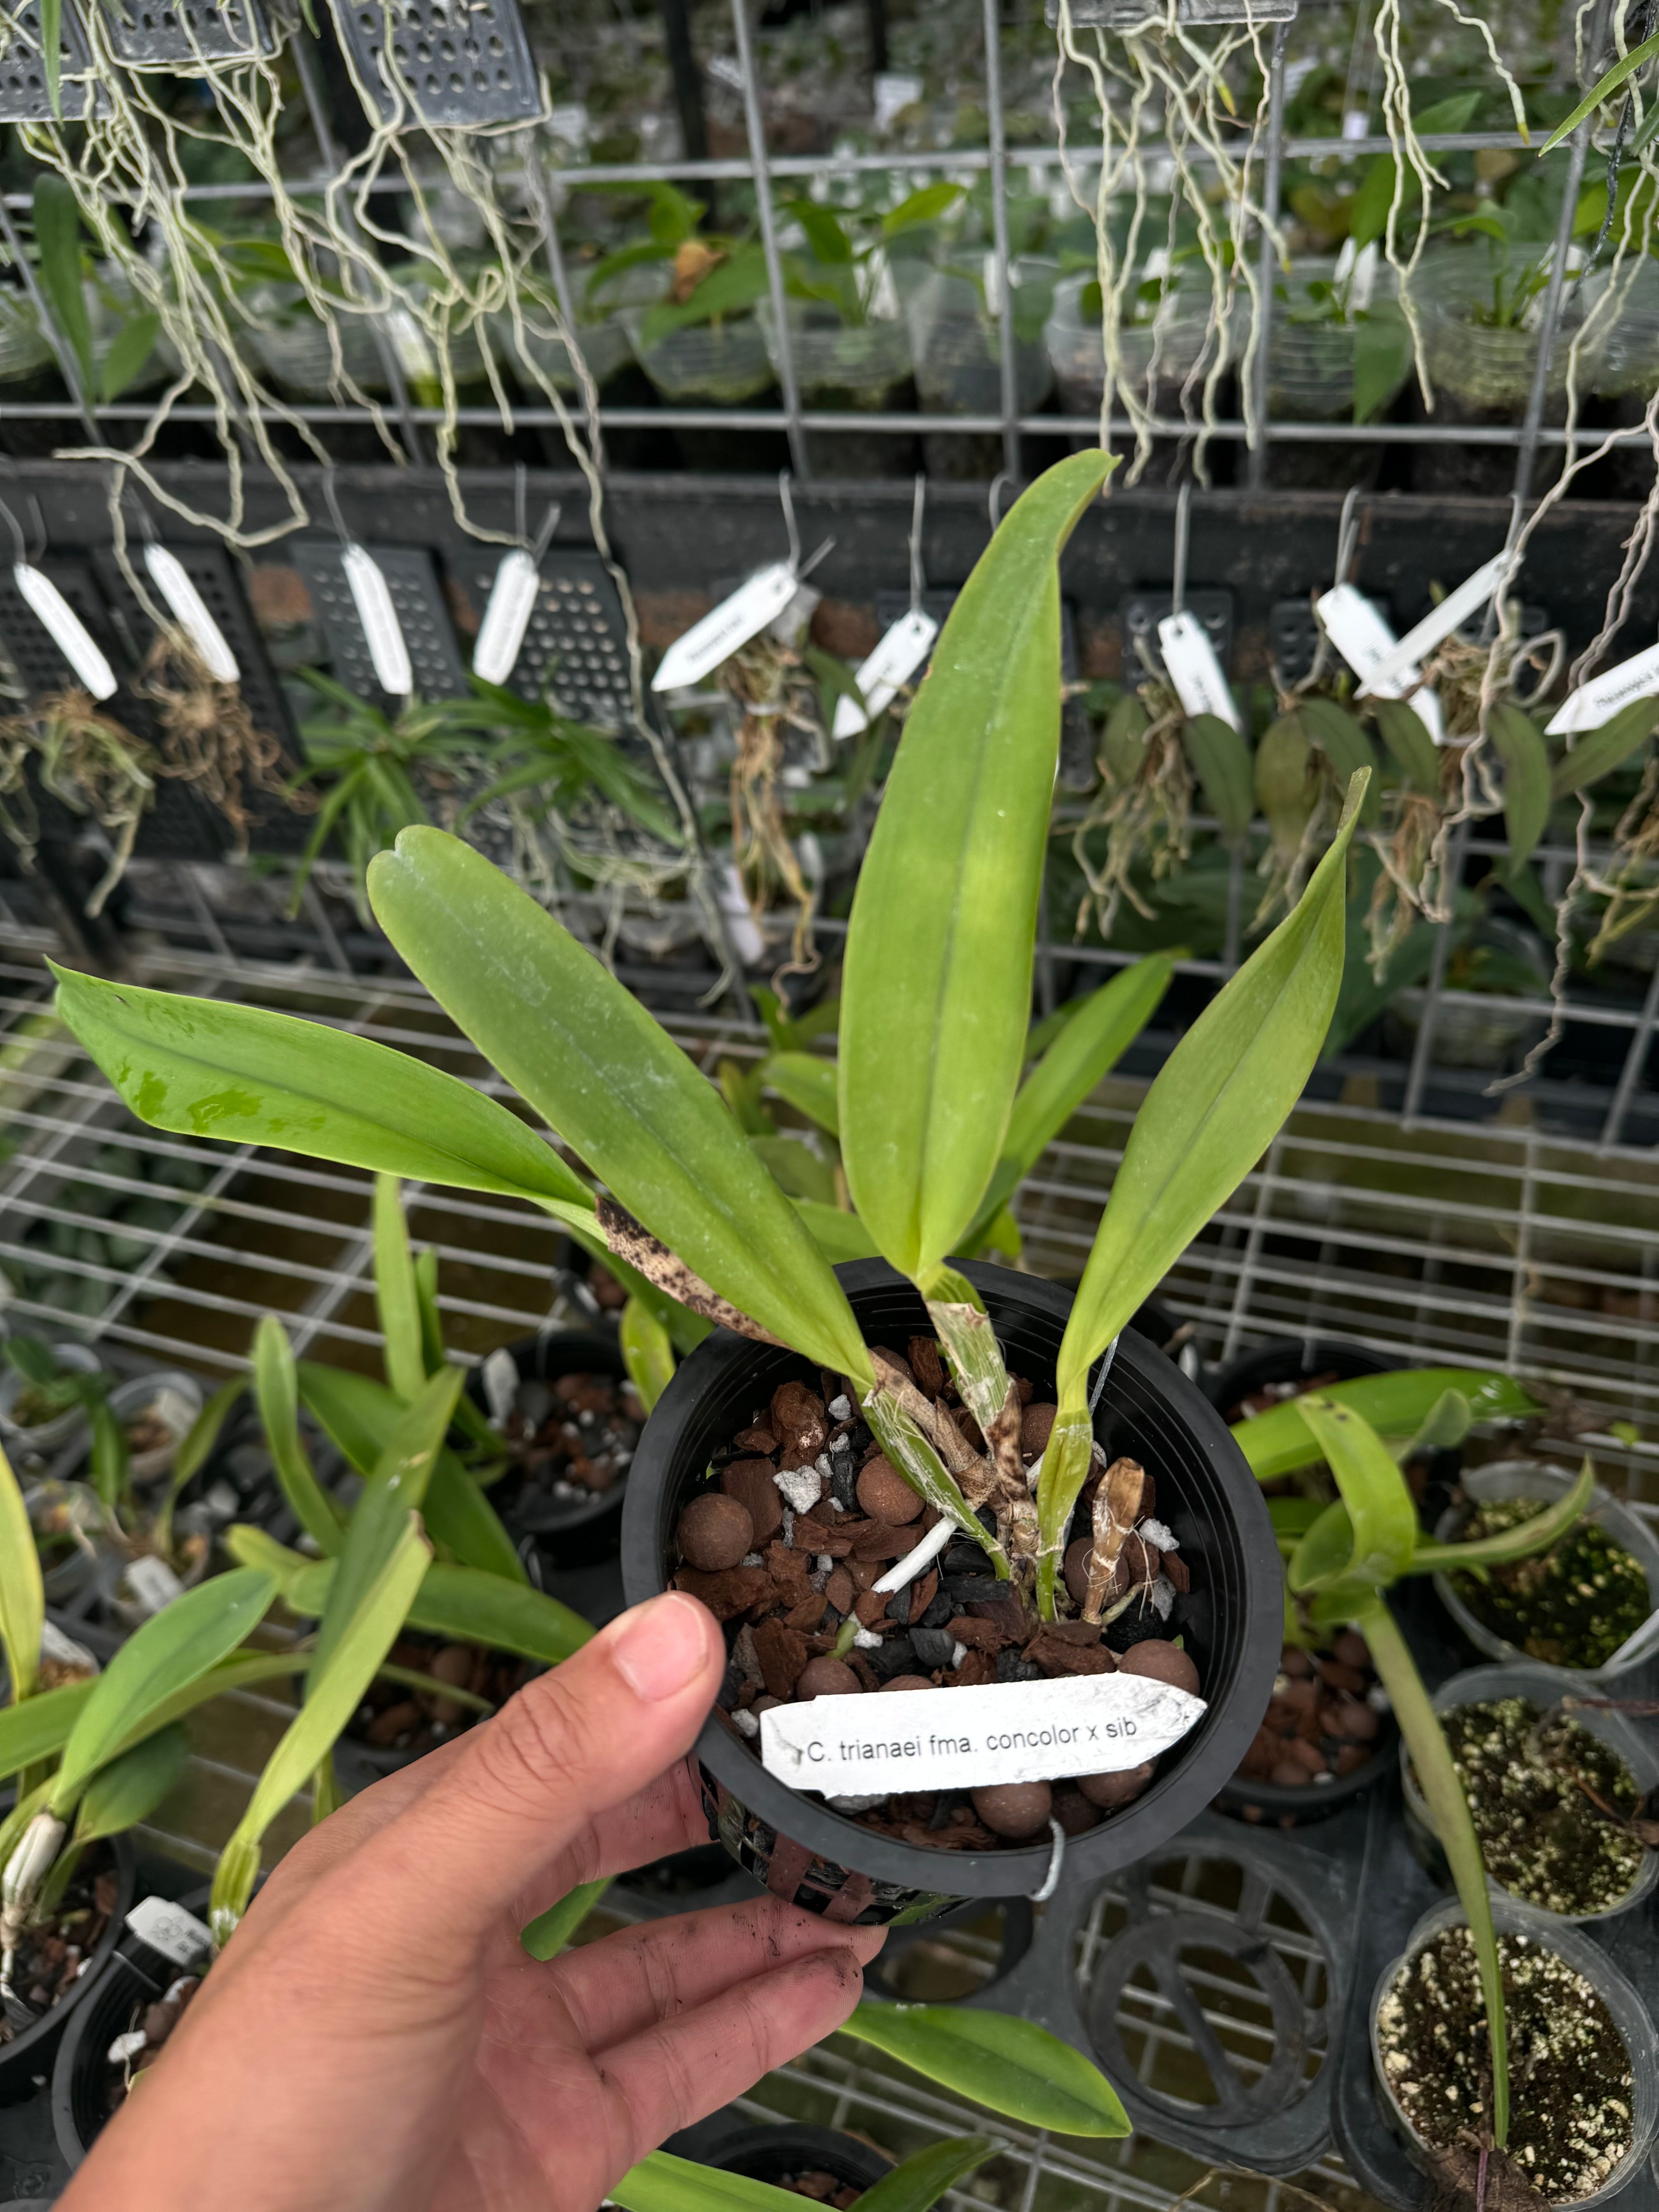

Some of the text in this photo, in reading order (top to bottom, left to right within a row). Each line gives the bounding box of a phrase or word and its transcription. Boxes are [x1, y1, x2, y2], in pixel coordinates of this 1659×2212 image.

[807, 1717, 1137, 1762] C. trianaei fma. concolor x sib
